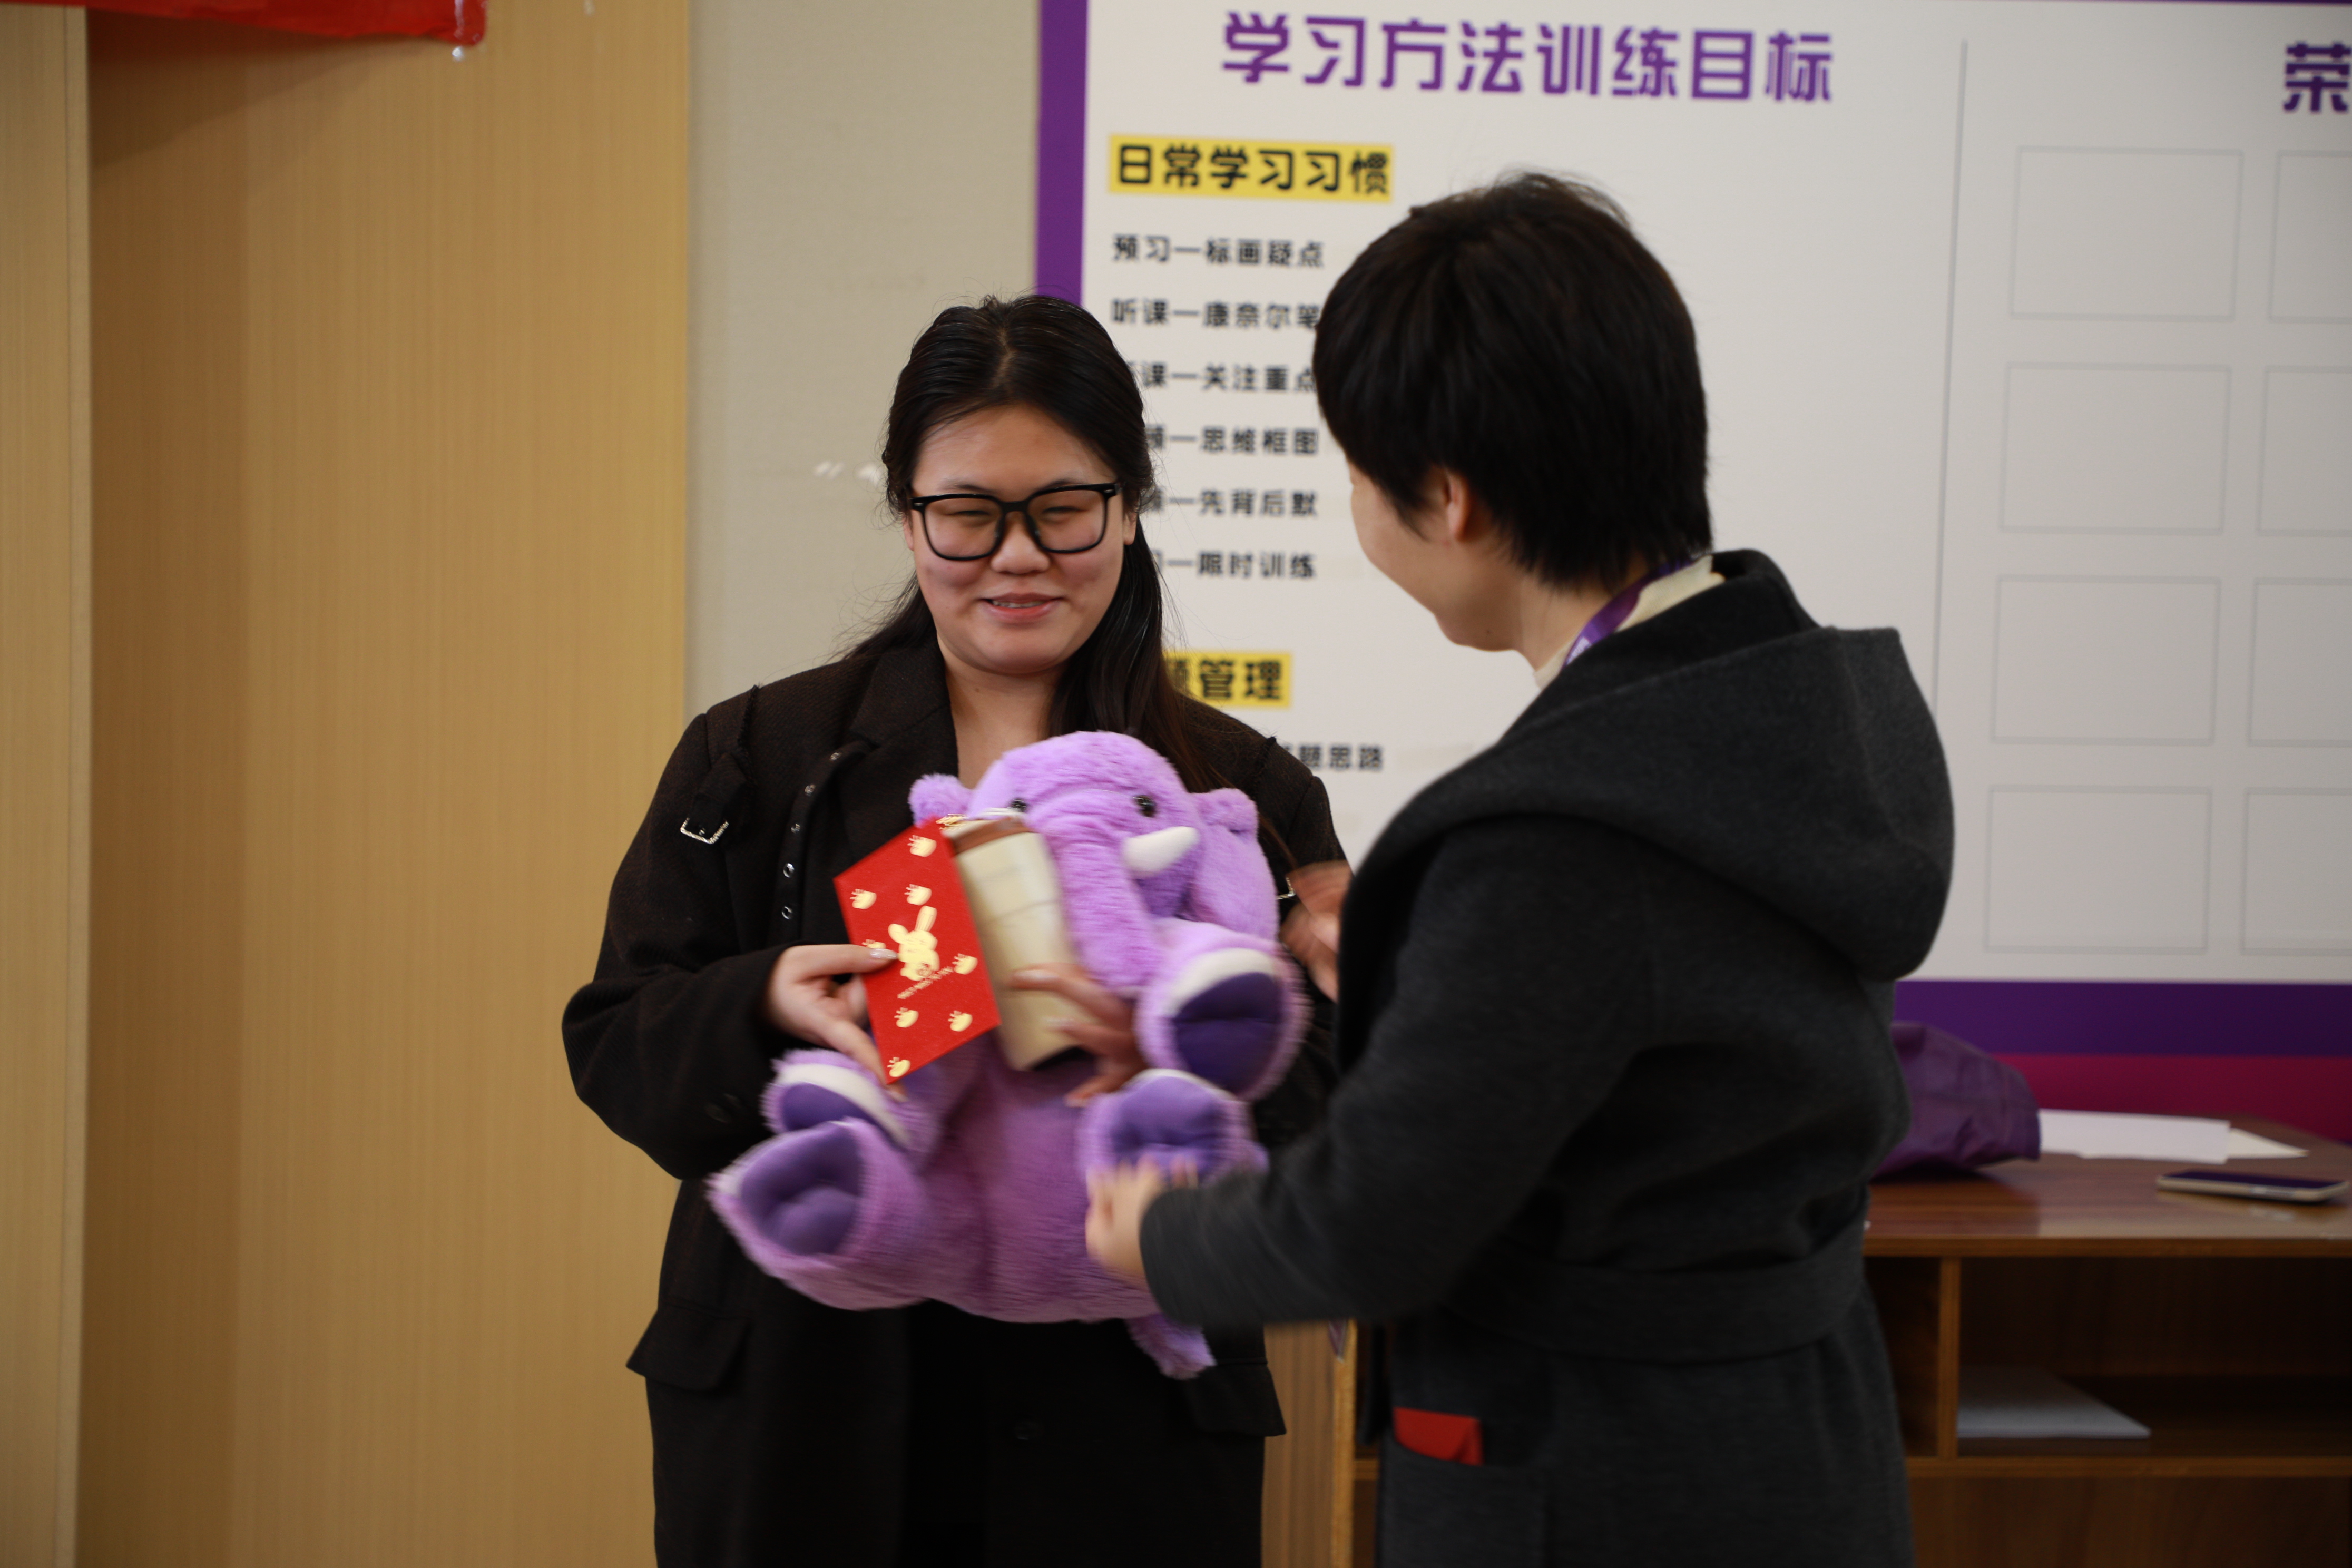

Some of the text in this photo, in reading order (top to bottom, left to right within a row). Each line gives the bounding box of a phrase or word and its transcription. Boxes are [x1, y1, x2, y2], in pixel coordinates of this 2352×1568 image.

[1222, 11, 1833, 102] 学习方法训练目标
[2284, 41, 2351, 112] 荣
[1119, 142, 1389, 195] 日常学习习惯
[1128, 361, 1317, 392] 课—关注重点
[1141, 486, 1317, 516] —先背后默
[1282, 742, 1383, 772] 题思路
